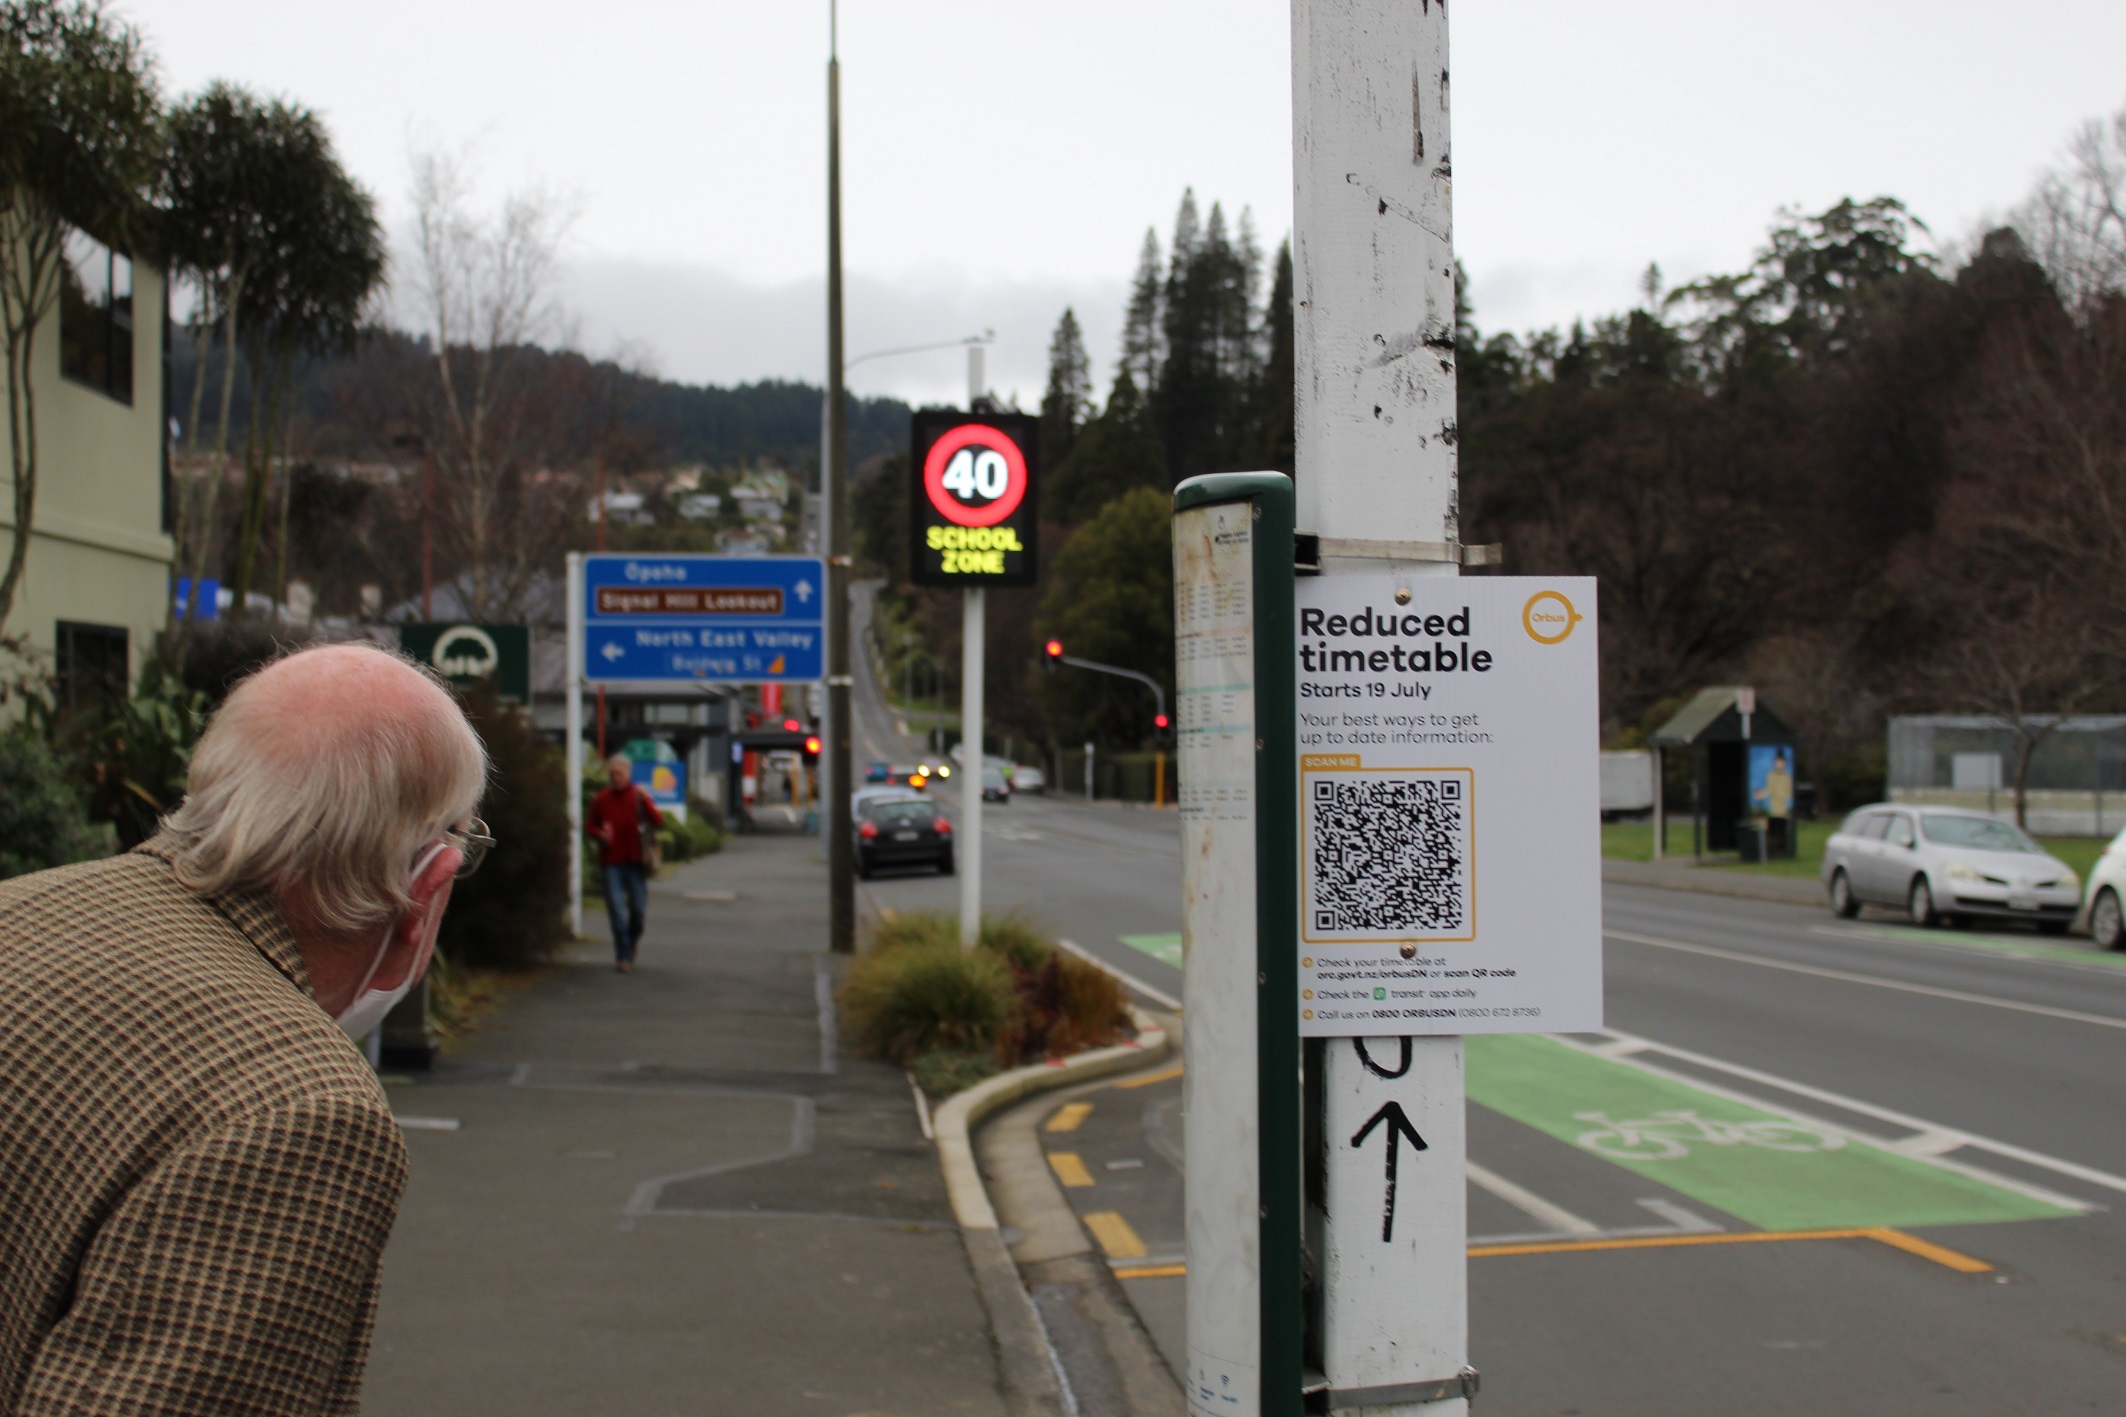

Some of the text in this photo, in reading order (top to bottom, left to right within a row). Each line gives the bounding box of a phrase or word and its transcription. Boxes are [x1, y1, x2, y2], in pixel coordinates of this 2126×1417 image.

[941, 449, 1008, 499] 40
[926, 525, 1023, 551] SCHOOL
[941, 549, 1005, 574] ZONE
[602, 592, 778, 612] Signal Hill Lookout
[1300, 606, 1470, 637] Reduced
[1532, 613, 1565, 623] Orbus
[637, 630, 813, 650] North East Valley
[1300, 641, 1493, 672] timetable
[1300, 681, 1432, 700] Starts 19 July
[1300, 712, 1479, 730] Your best ways to get
[1300, 729, 1494, 747] up to date information:
[1305, 757, 1357, 767] SCAN ME
[1317, 958, 1351, 967] Check
[1354, 959, 1378, 968] your
[1434, 957, 1447, 966] at
[1429, 970, 1442, 978] or
[1443, 970, 1469, 978] scan
[1471, 968, 1488, 979] QR
[1489, 968, 1517, 978] code
[1317, 990, 1351, 1000] Check
[1352, 989, 1370, 999] the
[1429, 990, 1451, 1000] app
[1451, 988, 1477, 999] daily
[1317, 1009, 1339, 1020] Call
[1341, 1011, 1354, 1019] us
[1355, 1010, 1370, 1019] on
[1371, 1009, 1400, 1019] 0800
[1402, 1008, 1457, 1019] ORBUSDN
[1491, 1007, 1511, 1018] 672
